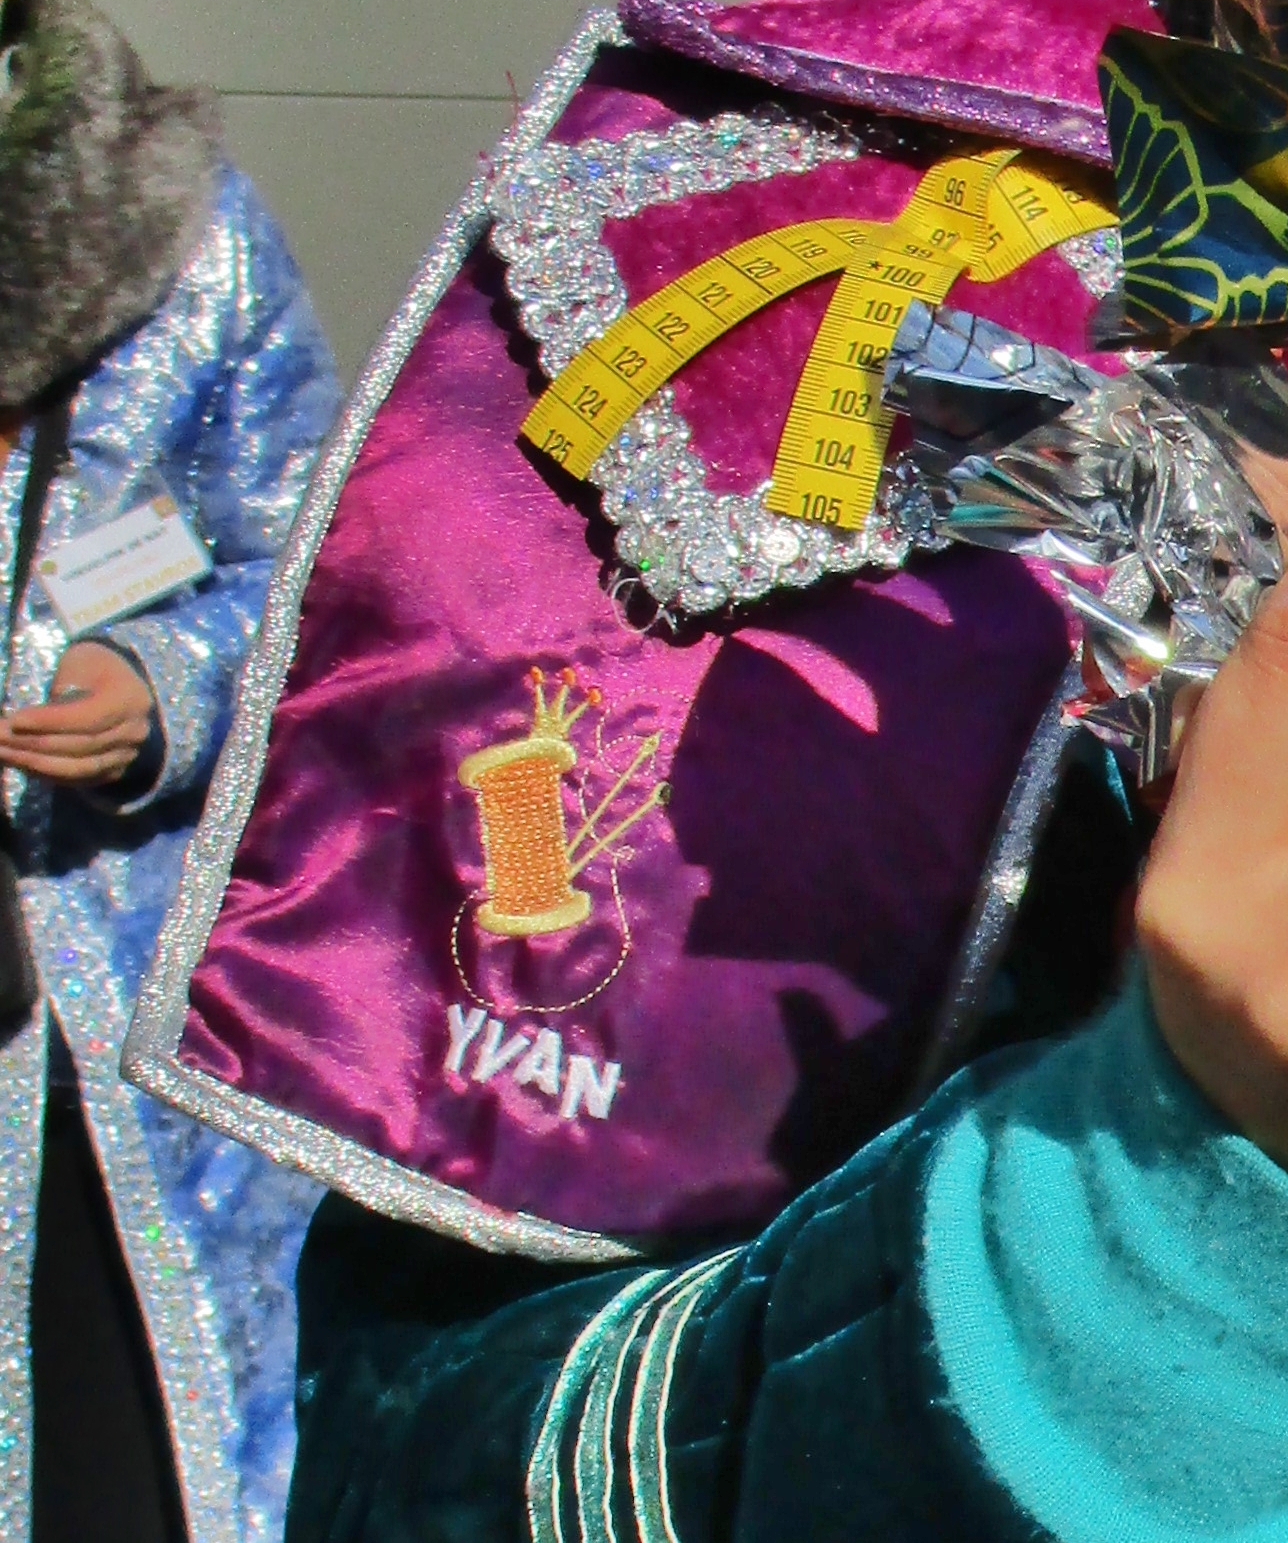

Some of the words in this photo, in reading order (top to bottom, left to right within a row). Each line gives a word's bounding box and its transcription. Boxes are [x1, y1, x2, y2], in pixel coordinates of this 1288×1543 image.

[944, 177, 967, 207] 96
[1010, 185, 1049, 223] 114
[790, 238, 828, 259] 119
[929, 228, 961, 250] 97
[740, 256, 781, 280] 120
[698, 282, 734, 308] 121
[653, 311, 691, 343] 122
[863, 299, 905, 325] 101
[611, 345, 648, 379] 123
[847, 340, 889, 369] 102
[572, 384, 608, 421] 124
[829, 388, 873, 418] 103
[541, 428, 574, 463] 125
[813, 437, 856, 471] 104
[800, 492, 843, 524] 105
[444, 1004, 622, 1121] YVAN
